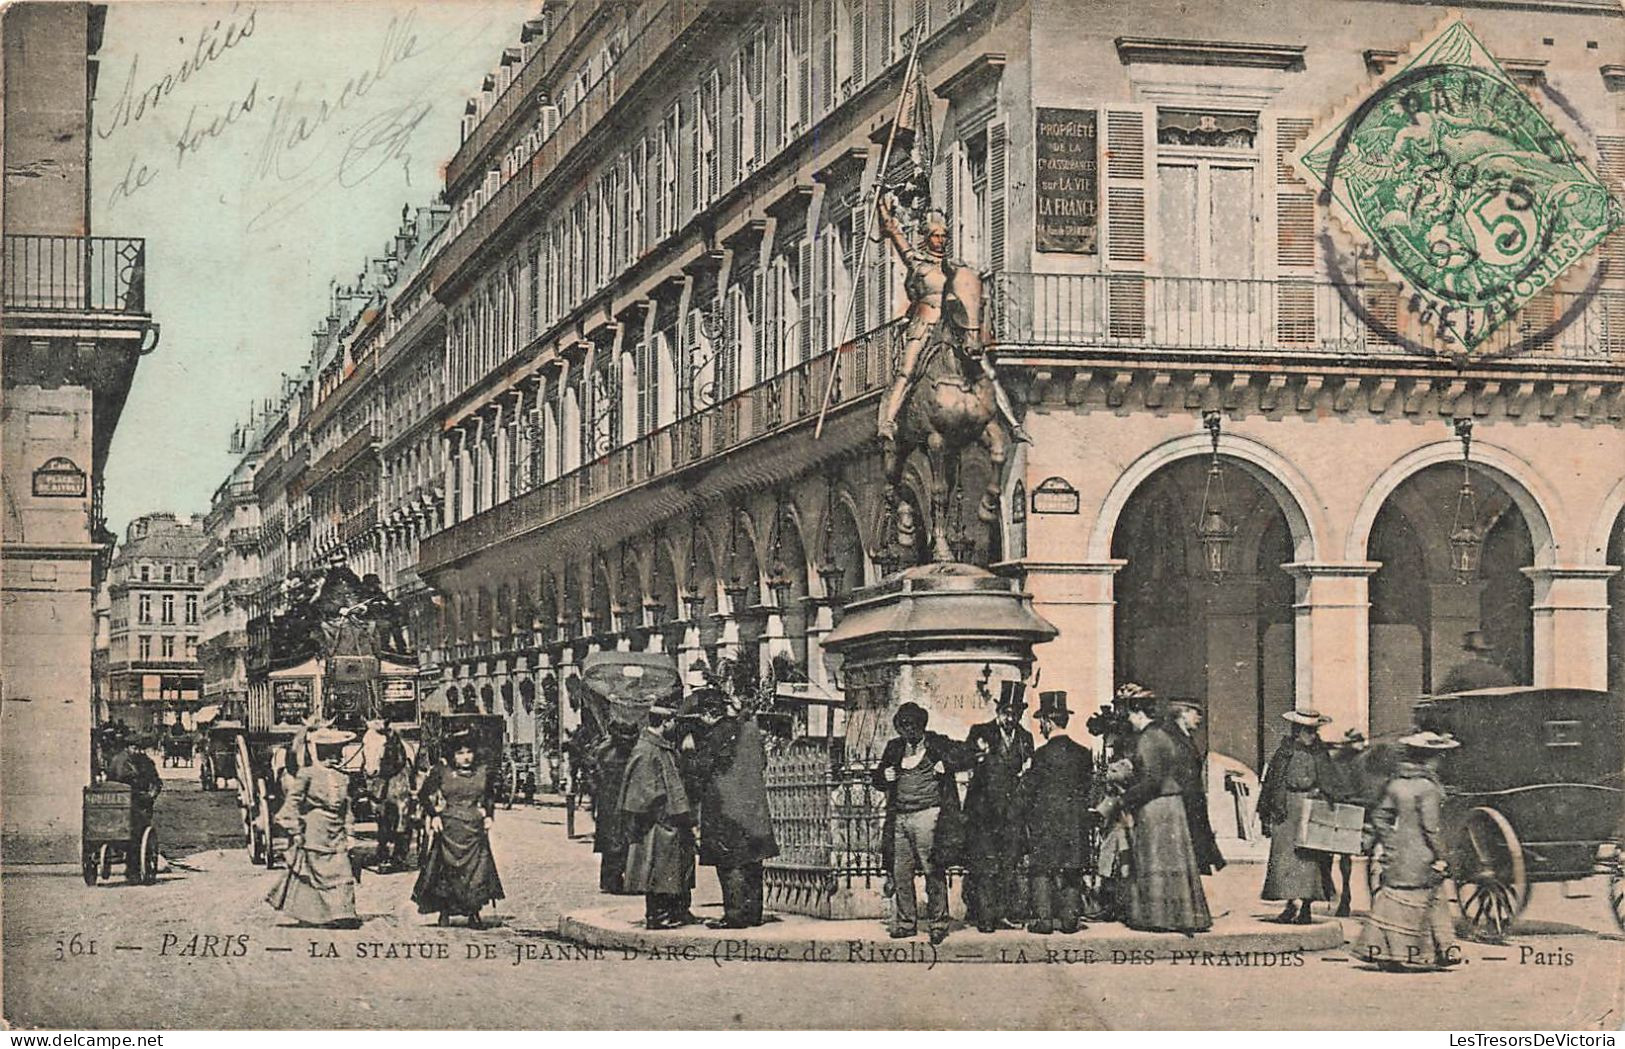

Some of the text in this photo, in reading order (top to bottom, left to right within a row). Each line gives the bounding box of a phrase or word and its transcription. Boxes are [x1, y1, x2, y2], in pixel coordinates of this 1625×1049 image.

[1052, 142, 1082, 153] DE LA
[108, 155, 160, 210] de
[1059, 177, 1073, 191] LA
[1039, 197, 1097, 217] LA FRANCE
[1472, 194, 1528, 256] 5
[1500, 238, 1579, 315] POSTES
[158, 934, 250, 957] PARIS
[308, 942, 341, 959] LA
[357, 942, 450, 959] STATUE
[466, 943, 497, 960] DE
[511, 944, 606, 967] JEANNE
[622, 939, 697, 961] D'ARC
[712, 938, 790, 968] (Place
[803, 939, 832, 962] de
[849, 939, 938, 970] Rivoli)
[1000, 949, 1029, 965] LA
[1047, 949, 1096, 965] RUE
[1111, 949, 1155, 965] DES
[1171, 950, 1306, 967] PYRAMIDES
[1518, 945, 1575, 967] Paris
